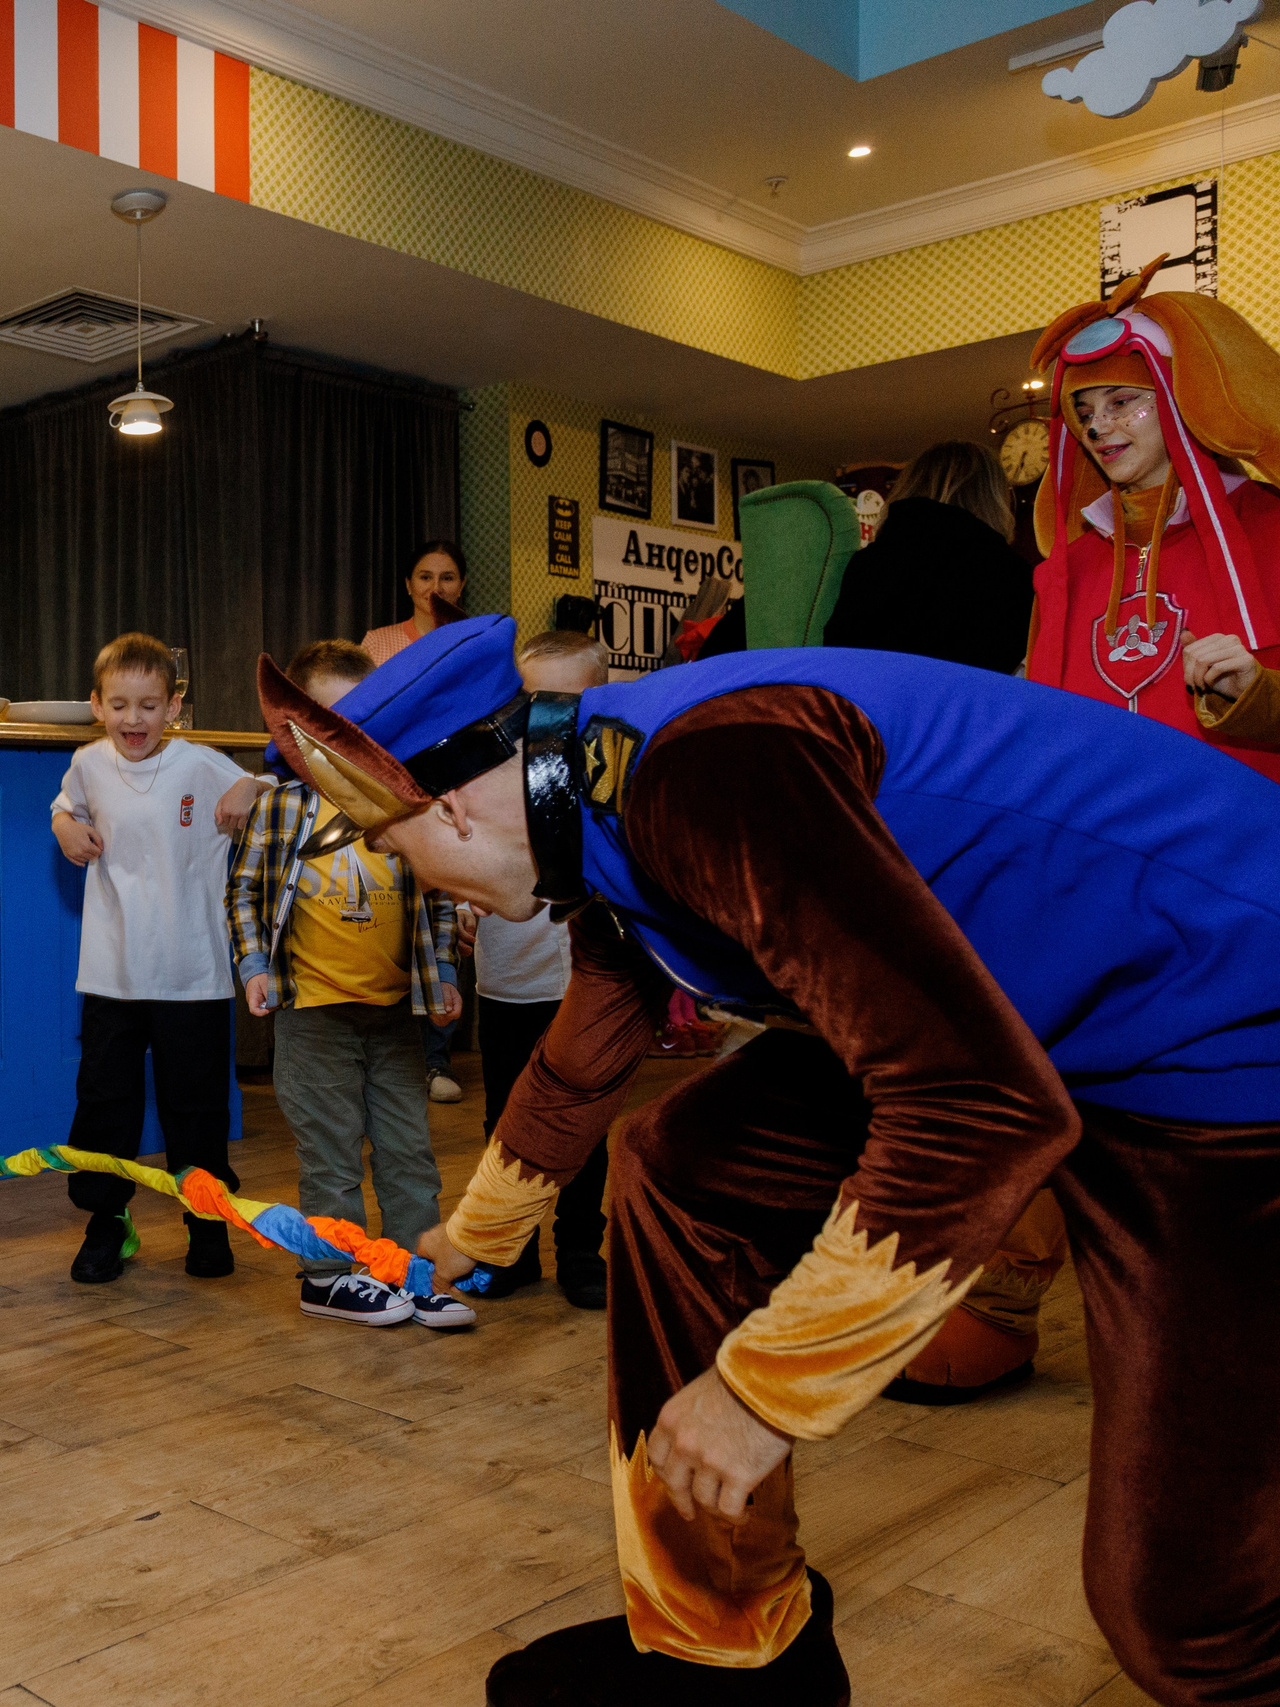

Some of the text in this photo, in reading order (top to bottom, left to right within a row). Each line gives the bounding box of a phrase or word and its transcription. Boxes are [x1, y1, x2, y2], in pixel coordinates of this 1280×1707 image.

[555, 519, 572, 540] KEEP
[553, 531, 573, 544] CALM
[556, 552, 572, 565] CALL
[550, 563, 579, 577] BATMAN
